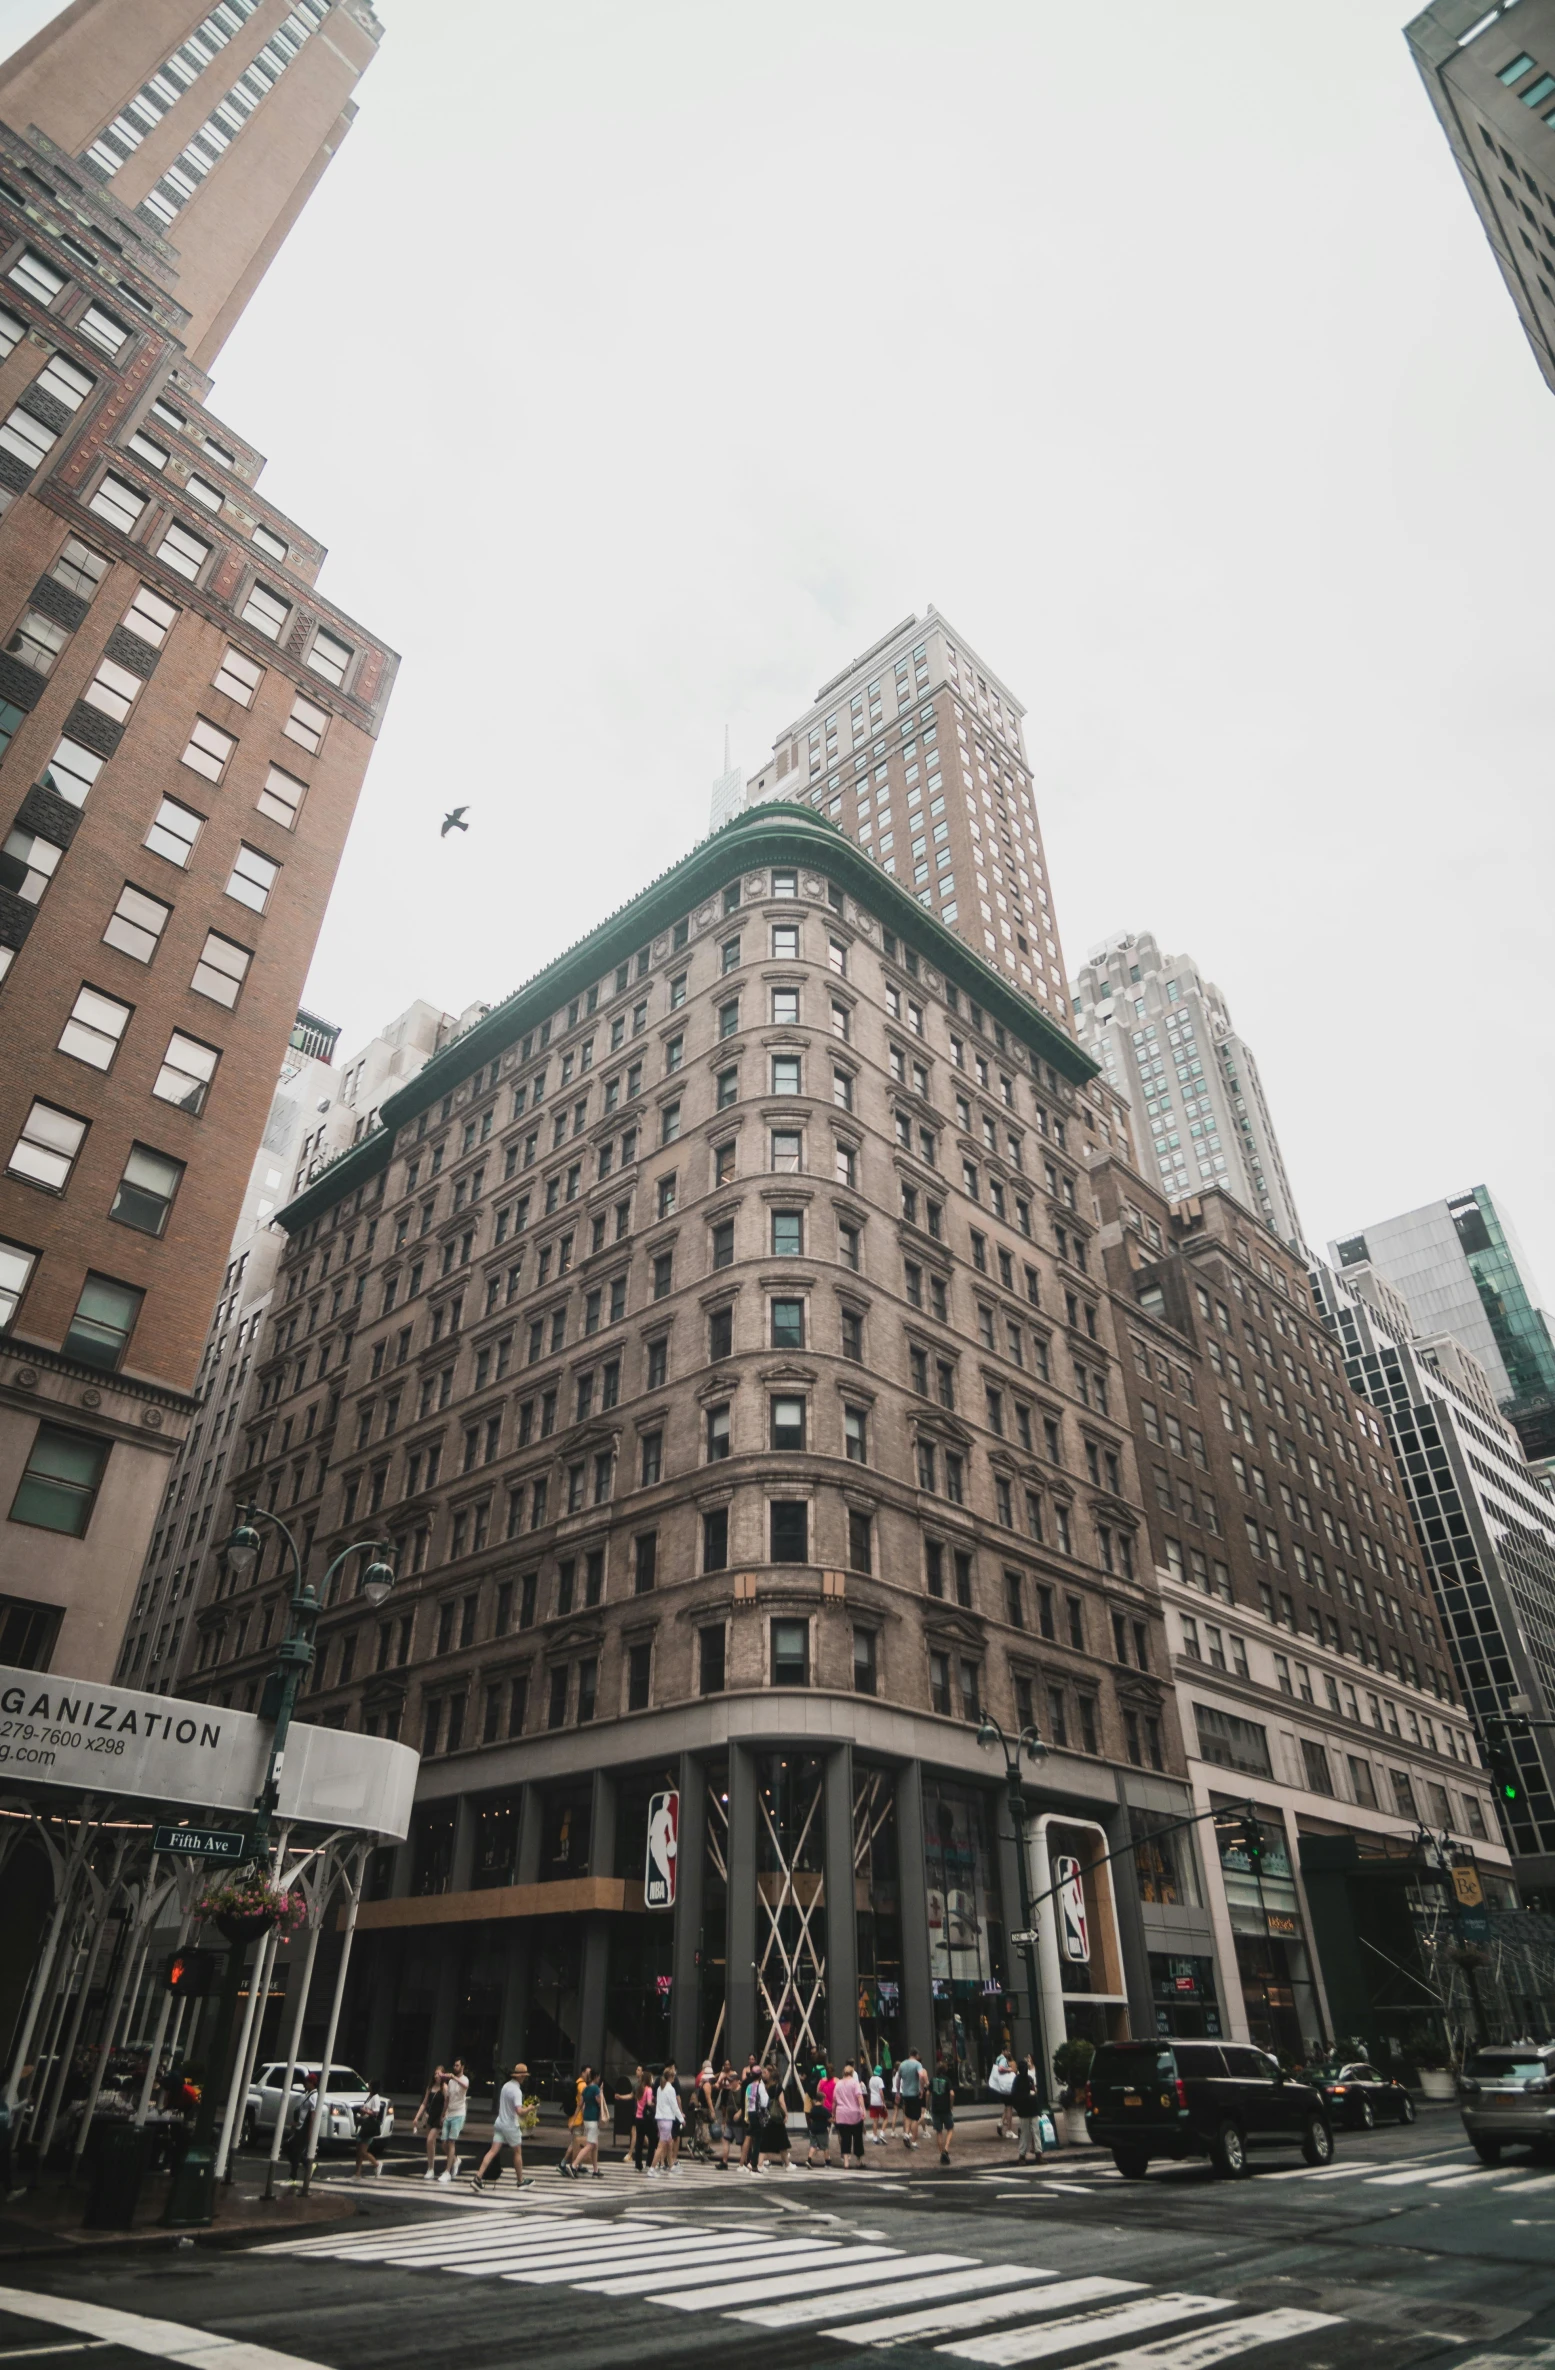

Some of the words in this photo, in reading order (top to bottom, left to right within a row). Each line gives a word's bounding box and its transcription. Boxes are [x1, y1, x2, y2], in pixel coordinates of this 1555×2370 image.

[1, 1687, 221, 1749] GANIZATION
[0, 1721, 82, 1748] 279-7600
[84, 1736, 125, 1755] x298
[169, 1833, 201, 1849] Fifth
[204, 1837, 229, 1851] Ave
[649, 1881, 665, 1900] NBA
